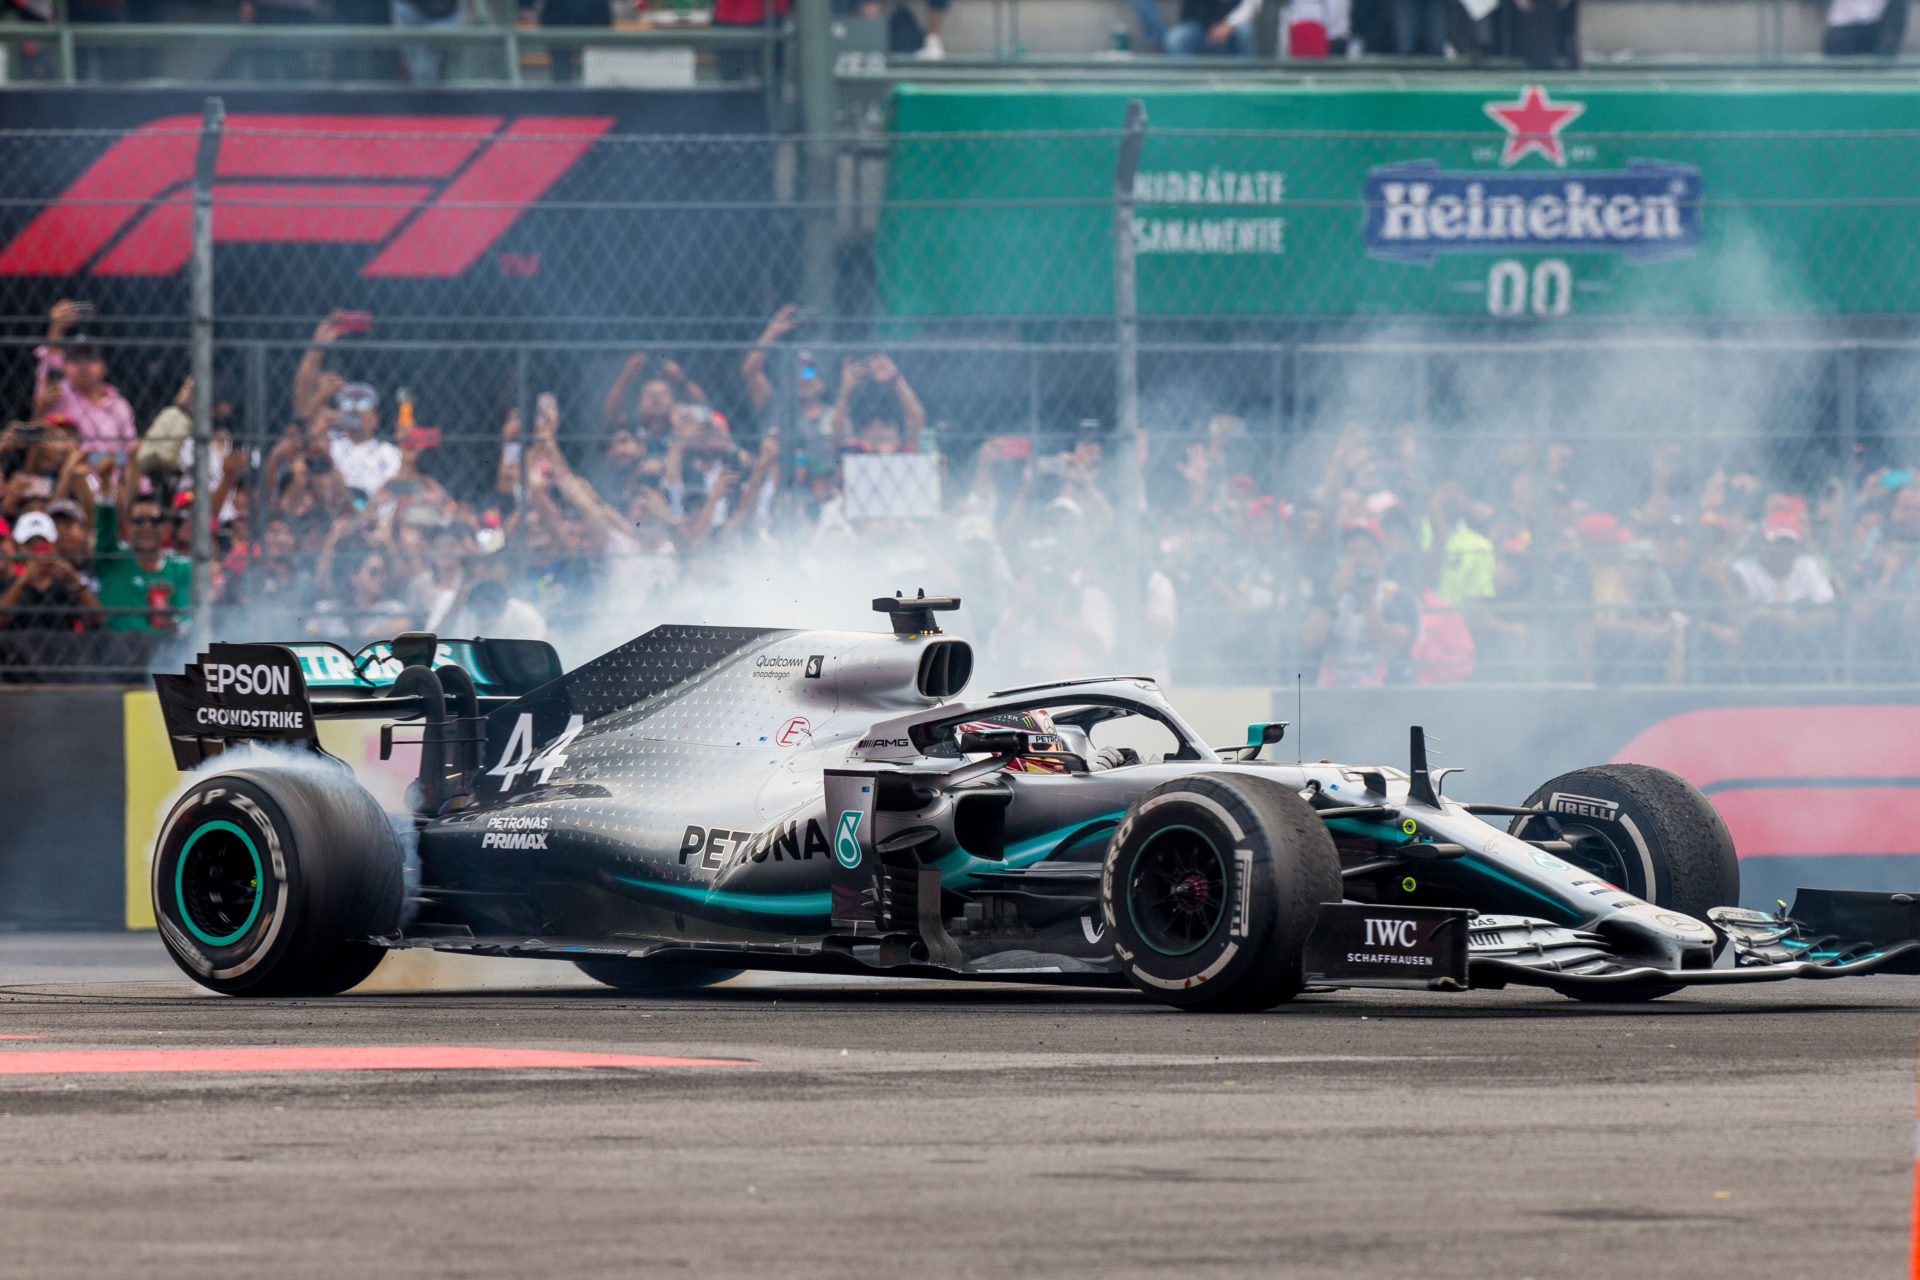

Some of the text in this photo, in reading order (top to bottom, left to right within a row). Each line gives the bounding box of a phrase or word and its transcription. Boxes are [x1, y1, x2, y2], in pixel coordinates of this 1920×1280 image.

[0, 113, 616, 276] F1
[1131, 217, 1286, 254] SANAMENTE
[756, 655, 803, 668] Qualcomm
[202, 663, 291, 696] EPSON
[752, 670, 791, 680] snapdragon
[196, 707, 304, 730] CROWDSTRIKE
[873, 738, 909, 748] AMG
[1035, 735, 1061, 744] PETRO
[485, 712, 585, 793] 44
[1548, 791, 1620, 823] PIRELLI
[486, 816, 549, 830] PETRONAS
[481, 832, 549, 851] PRIMAX
[677, 818, 832, 872] PETONA
[1364, 918, 1417, 948] IWC
[1347, 952, 1433, 966] SCHAFFHAUSEN
